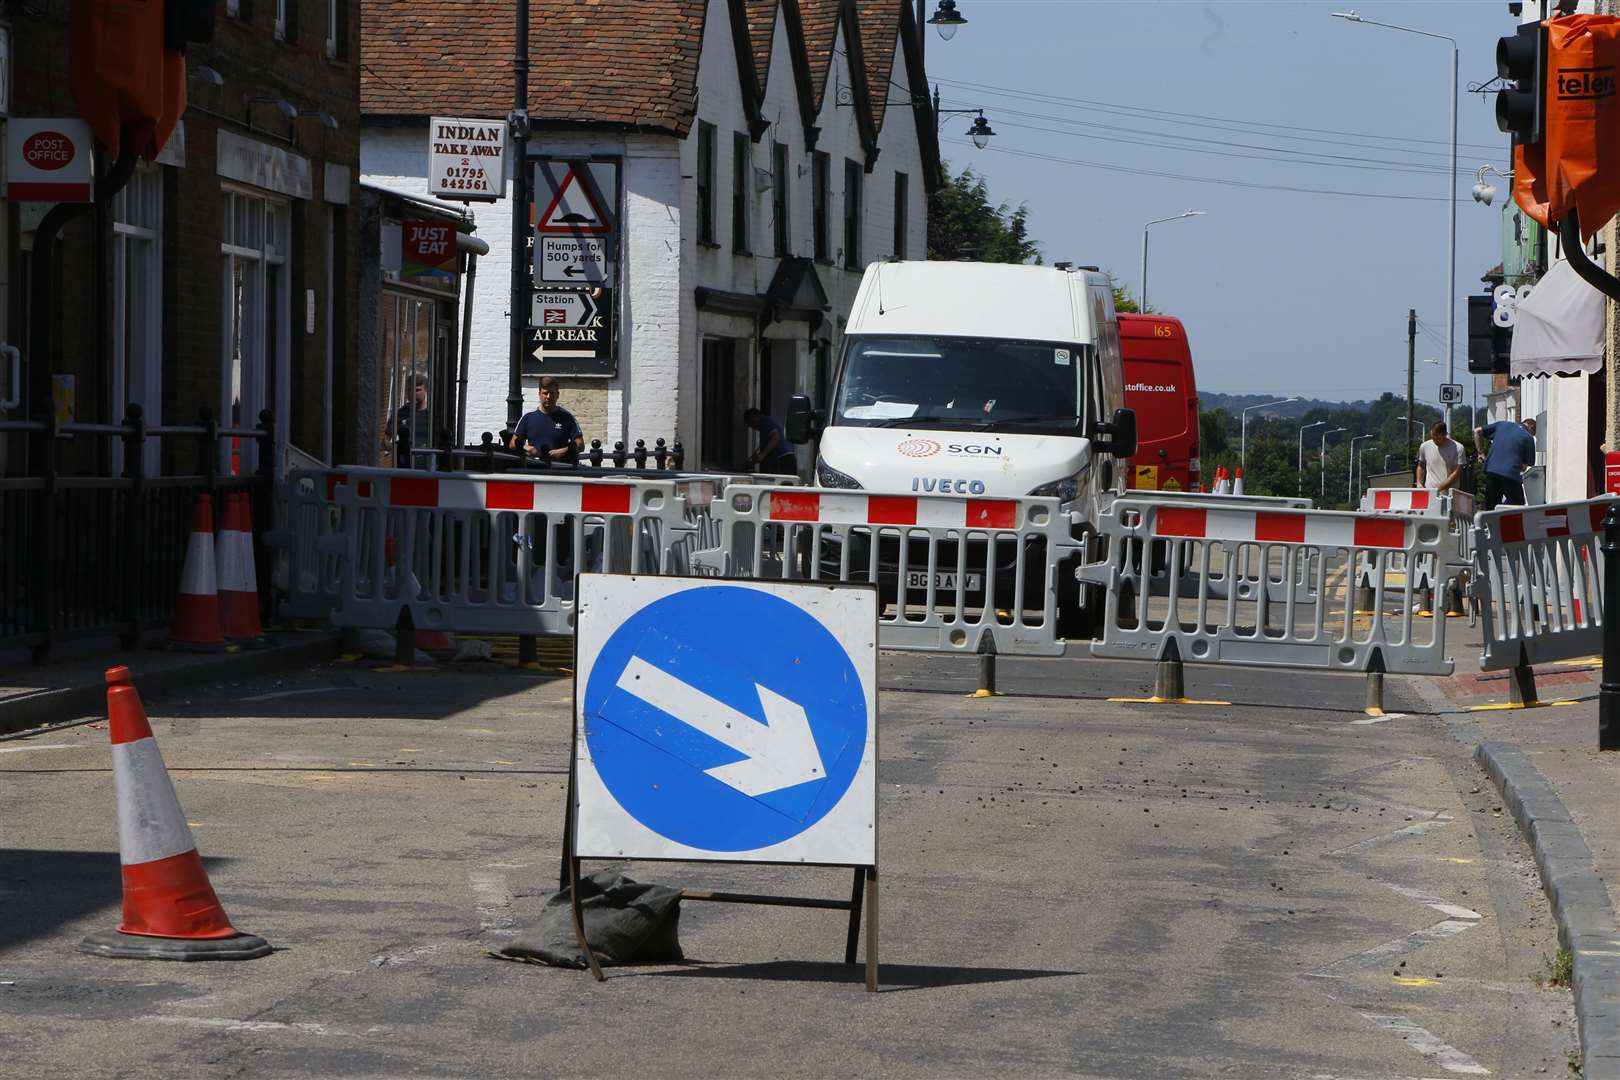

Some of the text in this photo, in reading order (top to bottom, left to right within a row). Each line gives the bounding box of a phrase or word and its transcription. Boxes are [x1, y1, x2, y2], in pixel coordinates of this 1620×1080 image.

[438, 125, 500, 142] INDIAN
[34, 139, 65, 150] POST
[433, 143, 503, 157] TAKE AWAY
[27, 150, 70, 161] OFFICE
[446, 167, 484, 179] 01795
[441, 178, 488, 191] 842561
[411, 227, 449, 242] JUST
[418, 241, 449, 255] EAT
[547, 241, 602, 252] Humps for
[547, 253, 602, 264] 500 yards
[536, 295, 574, 304] Station
[533, 329, 598, 341] AT REAR
[1154, 324, 1172, 337] 165
[947, 444, 1003, 456] SGN
[912, 477, 985, 495] IVECO
